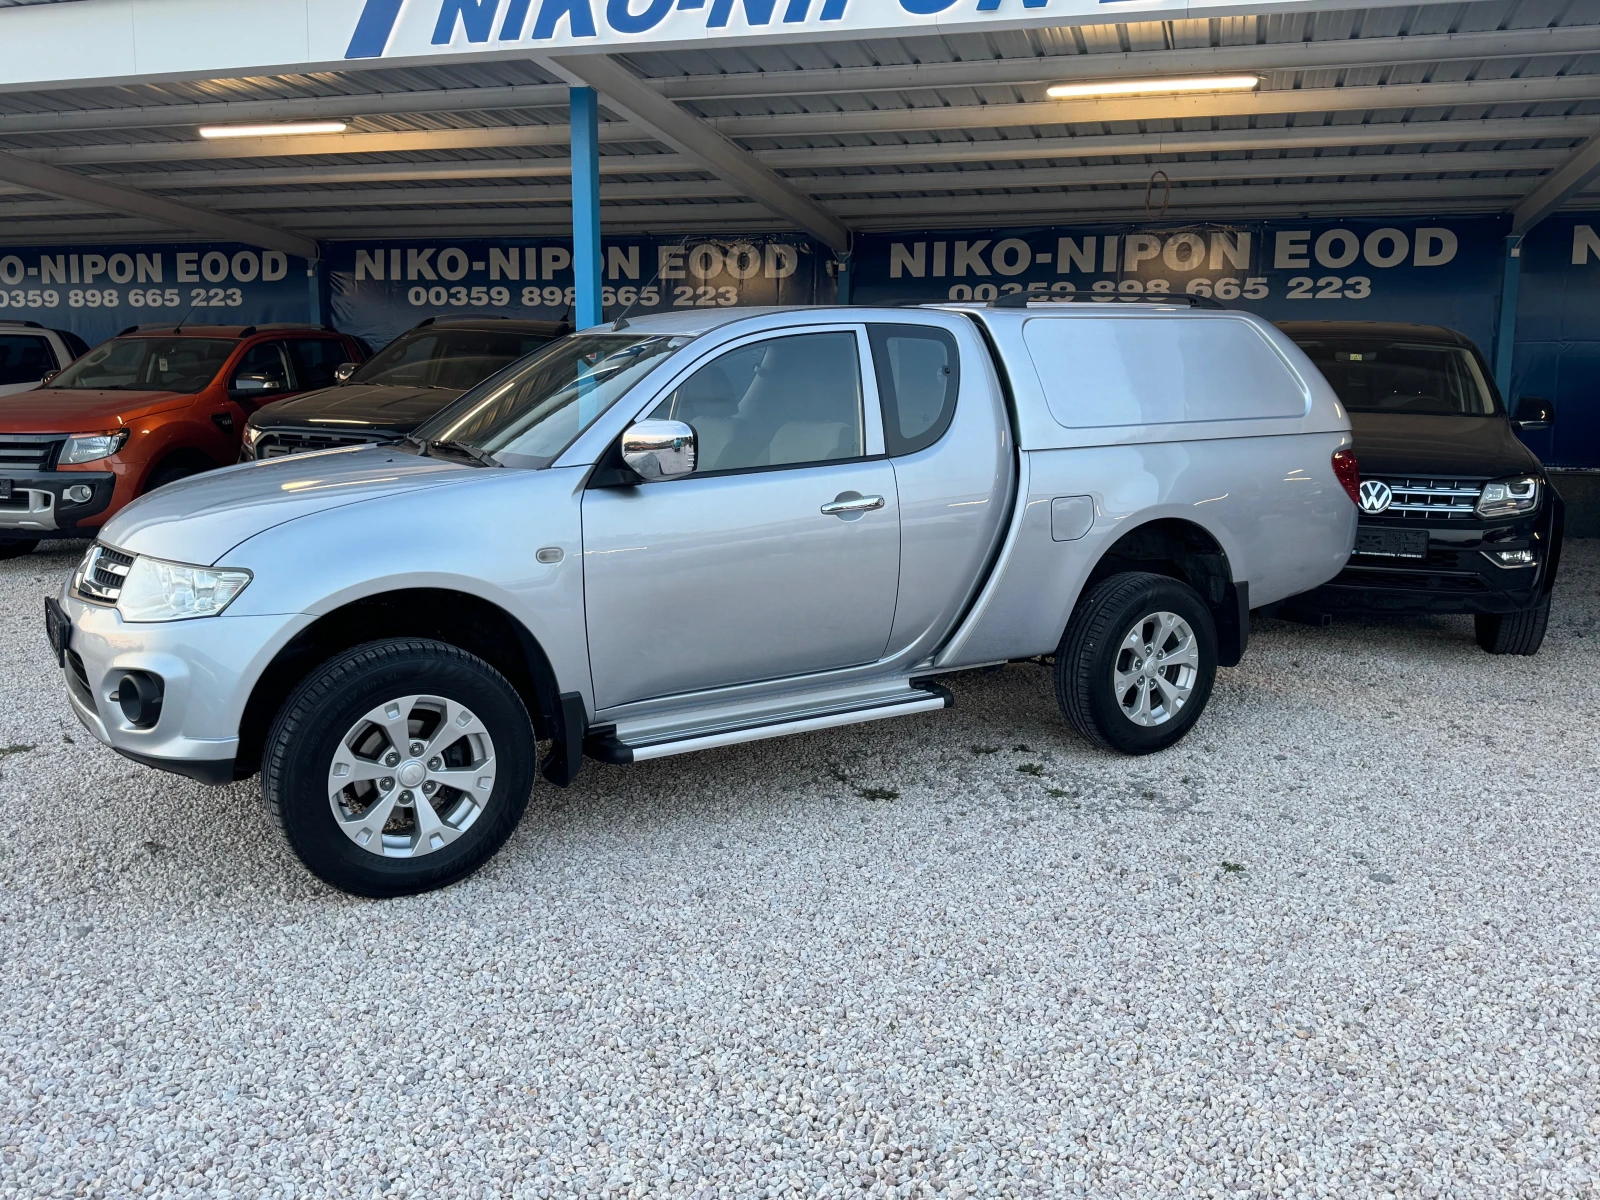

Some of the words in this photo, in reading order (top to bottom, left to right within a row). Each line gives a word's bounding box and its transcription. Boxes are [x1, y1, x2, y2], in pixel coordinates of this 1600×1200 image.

[176, 250, 288, 283] EOOD
[354, 245, 640, 281] NIKO-NIPN
[657, 243, 798, 280] EOOD
[889, 231, 1251, 279] NIKO-NIPON
[1273, 227, 1459, 269] EOOD
[68, 288, 120, 308] 898
[128, 288, 181, 308] 665
[190, 287, 243, 307] 223
[407, 286, 510, 307] 00359
[521, 286, 576, 307] 898
[601, 285, 660, 307] 665
[672, 285, 739, 307] 223
[1090, 279, 1171, 302] 898
[1185, 276, 1269, 300] 665
[1285, 275, 1372, 299] 223
